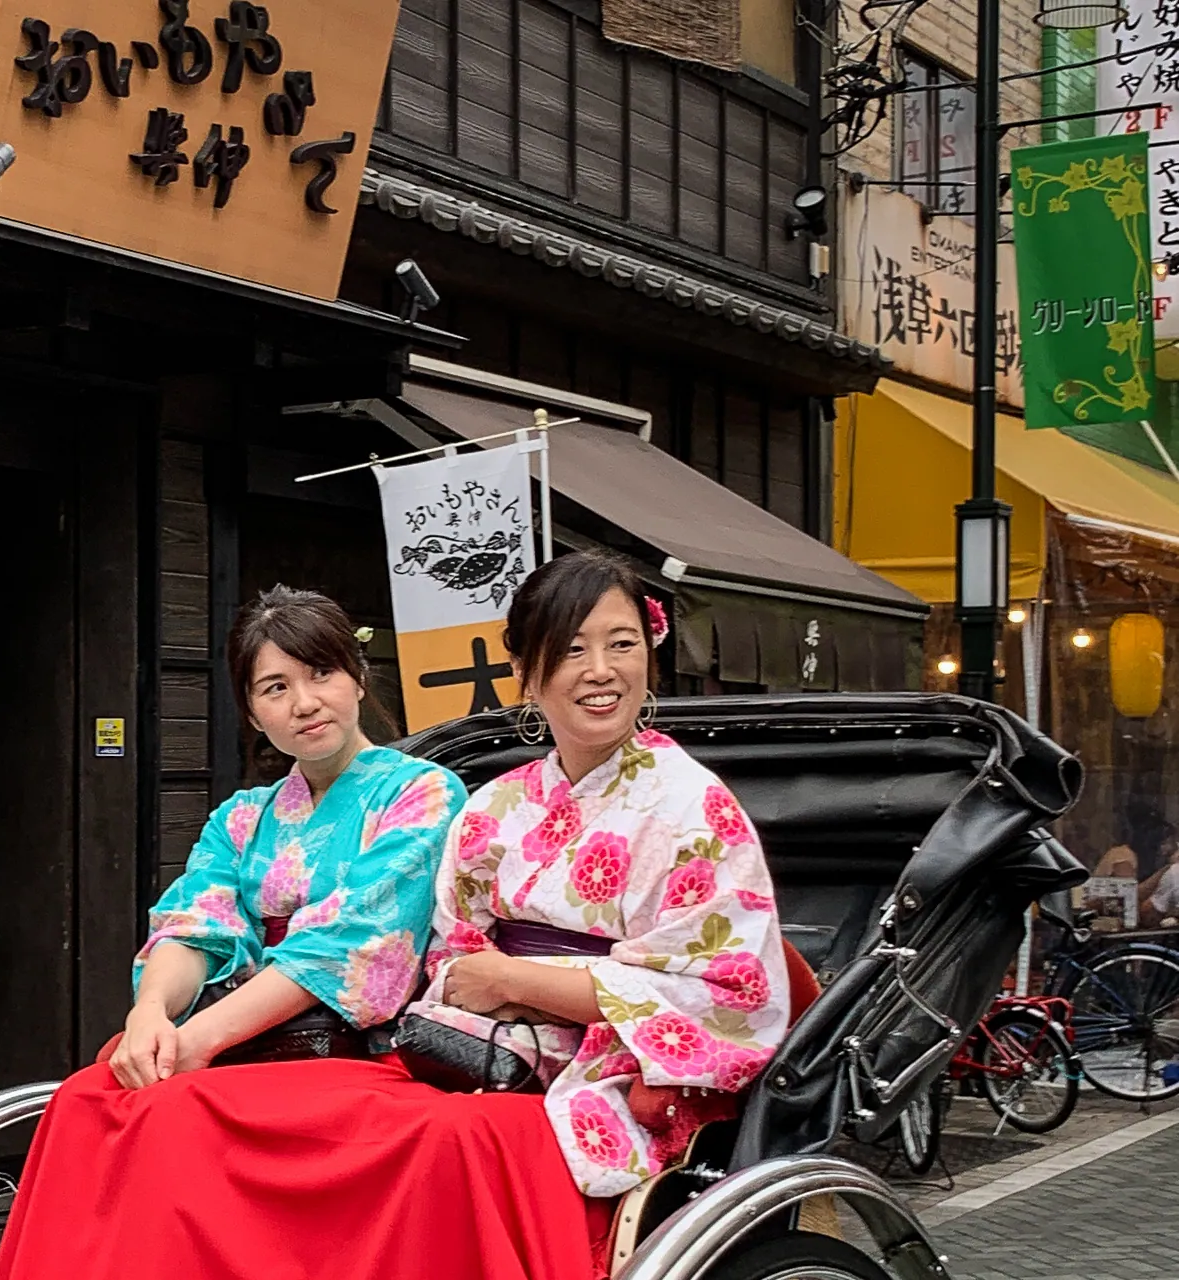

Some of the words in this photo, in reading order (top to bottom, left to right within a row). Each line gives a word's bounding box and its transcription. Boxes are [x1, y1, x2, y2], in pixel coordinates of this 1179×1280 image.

[1031, 291, 1151, 335] グリーンロード
[405, 480, 522, 533] おいもやさん
